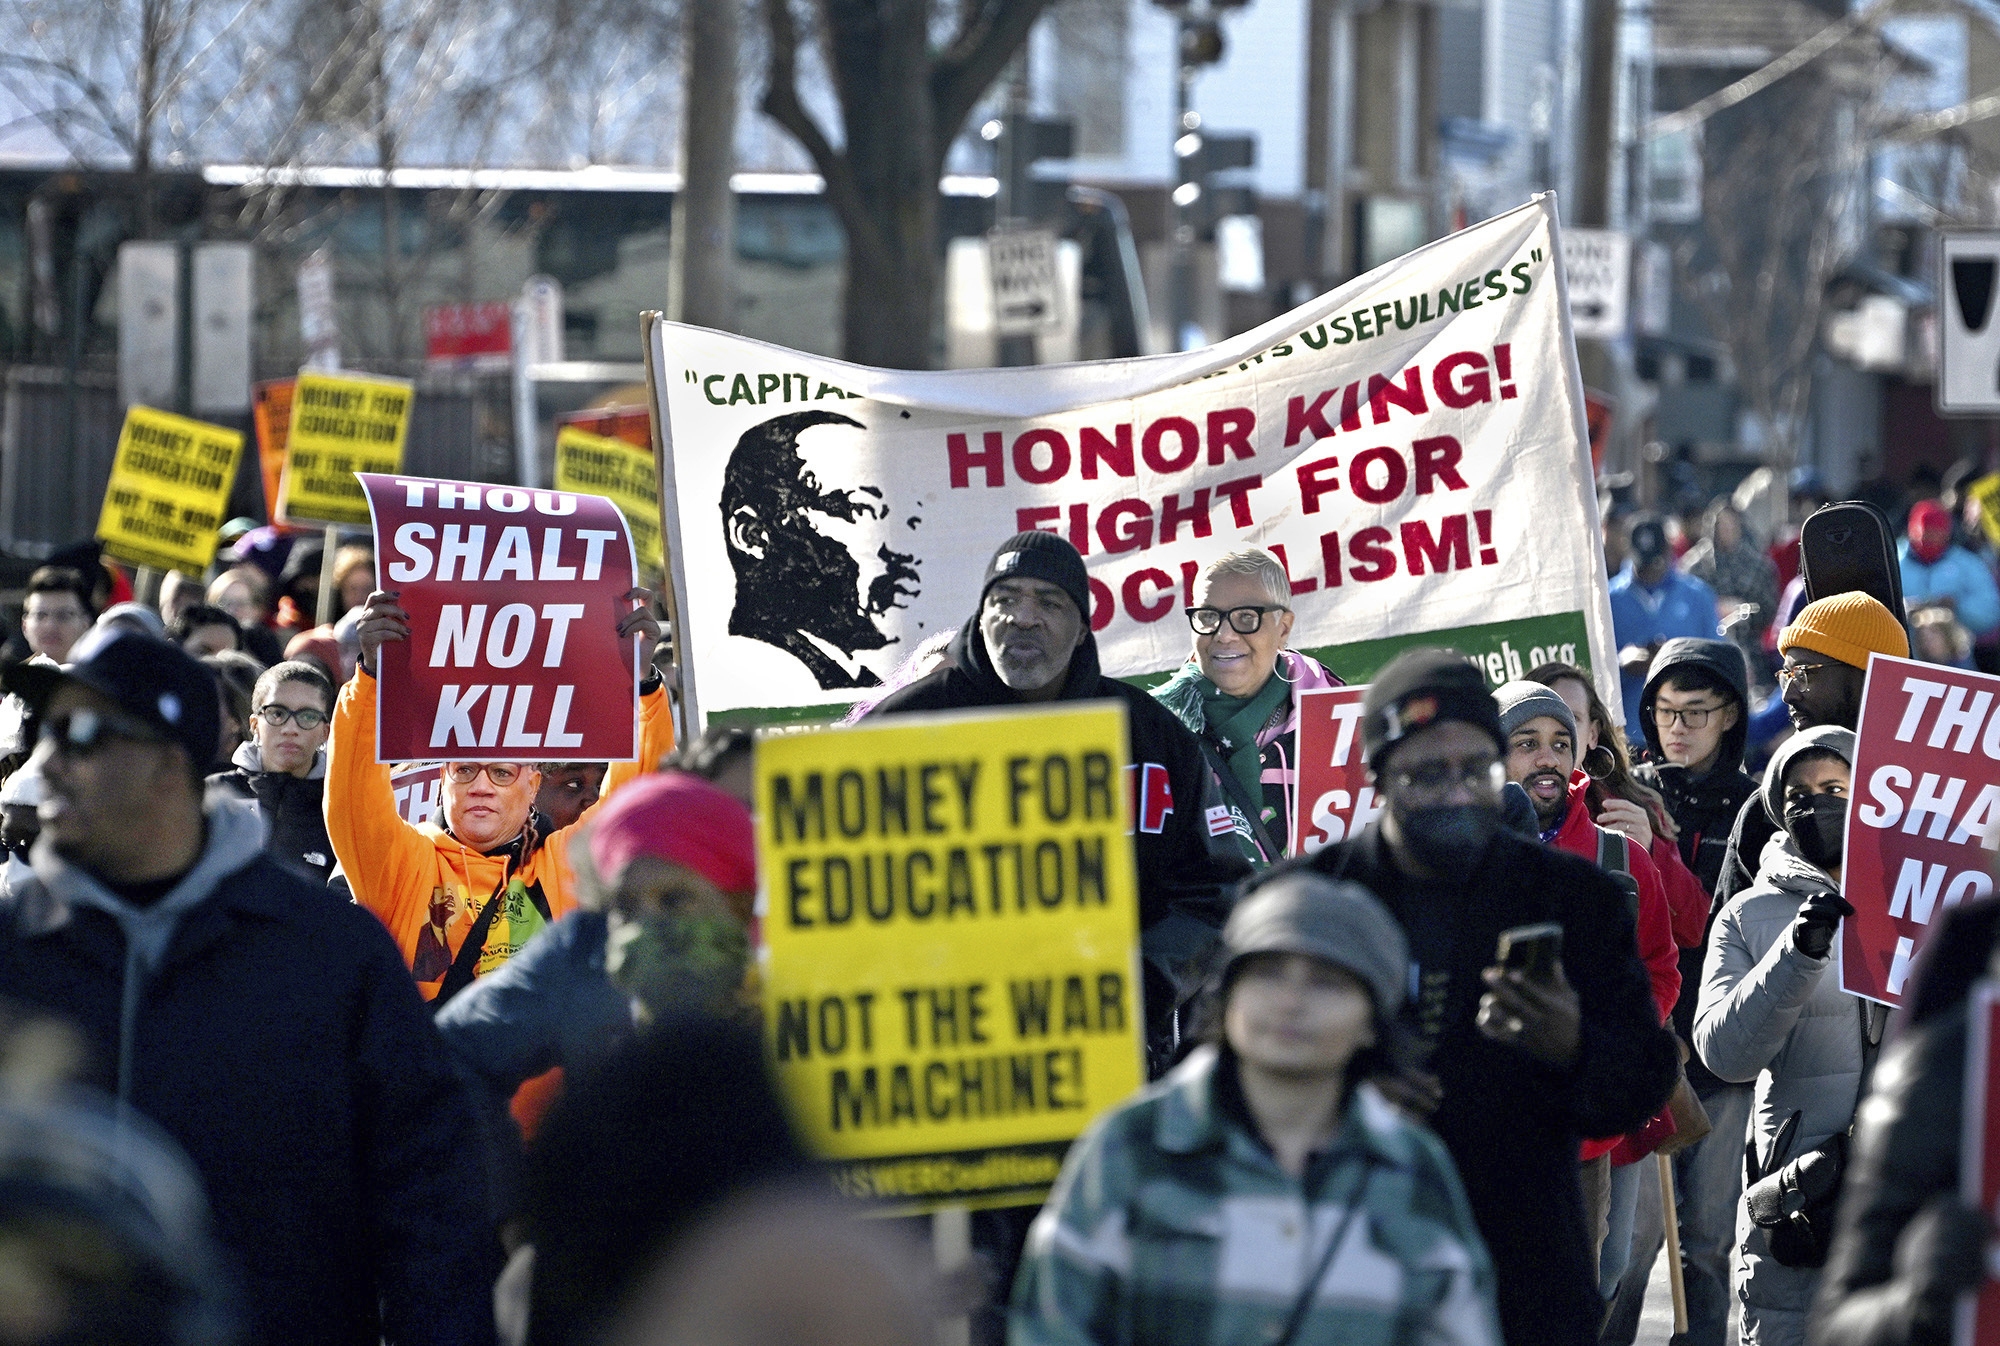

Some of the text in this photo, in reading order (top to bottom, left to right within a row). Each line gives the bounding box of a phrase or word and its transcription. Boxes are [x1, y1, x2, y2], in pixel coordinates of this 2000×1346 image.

[684, 368, 866, 406] "CAPITA
[1299, 248, 1543, 350] USEFULNESS"
[946, 343, 1518, 488] HONOR KING!
[395, 480, 577, 516] THOU
[1016, 435, 1469, 556] FIGHT FOR
[388, 522, 617, 583] SHALT
[429, 603, 585, 669] NOT
[429, 684, 584, 748] KILL
[1330, 702, 1372, 768] T
[393, 778, 442, 826] TH
[769, 748, 1116, 847] MONEY FOR
[1304, 786, 1388, 855] SH
[1859, 765, 2000, 851] SHA
[785, 836, 1109, 930] EDUCATION
[1888, 857, 2000, 926] NO
[776, 973, 1126, 1061] NOT THE WAR
[830, 1047, 1085, 1133] MACHINE!
